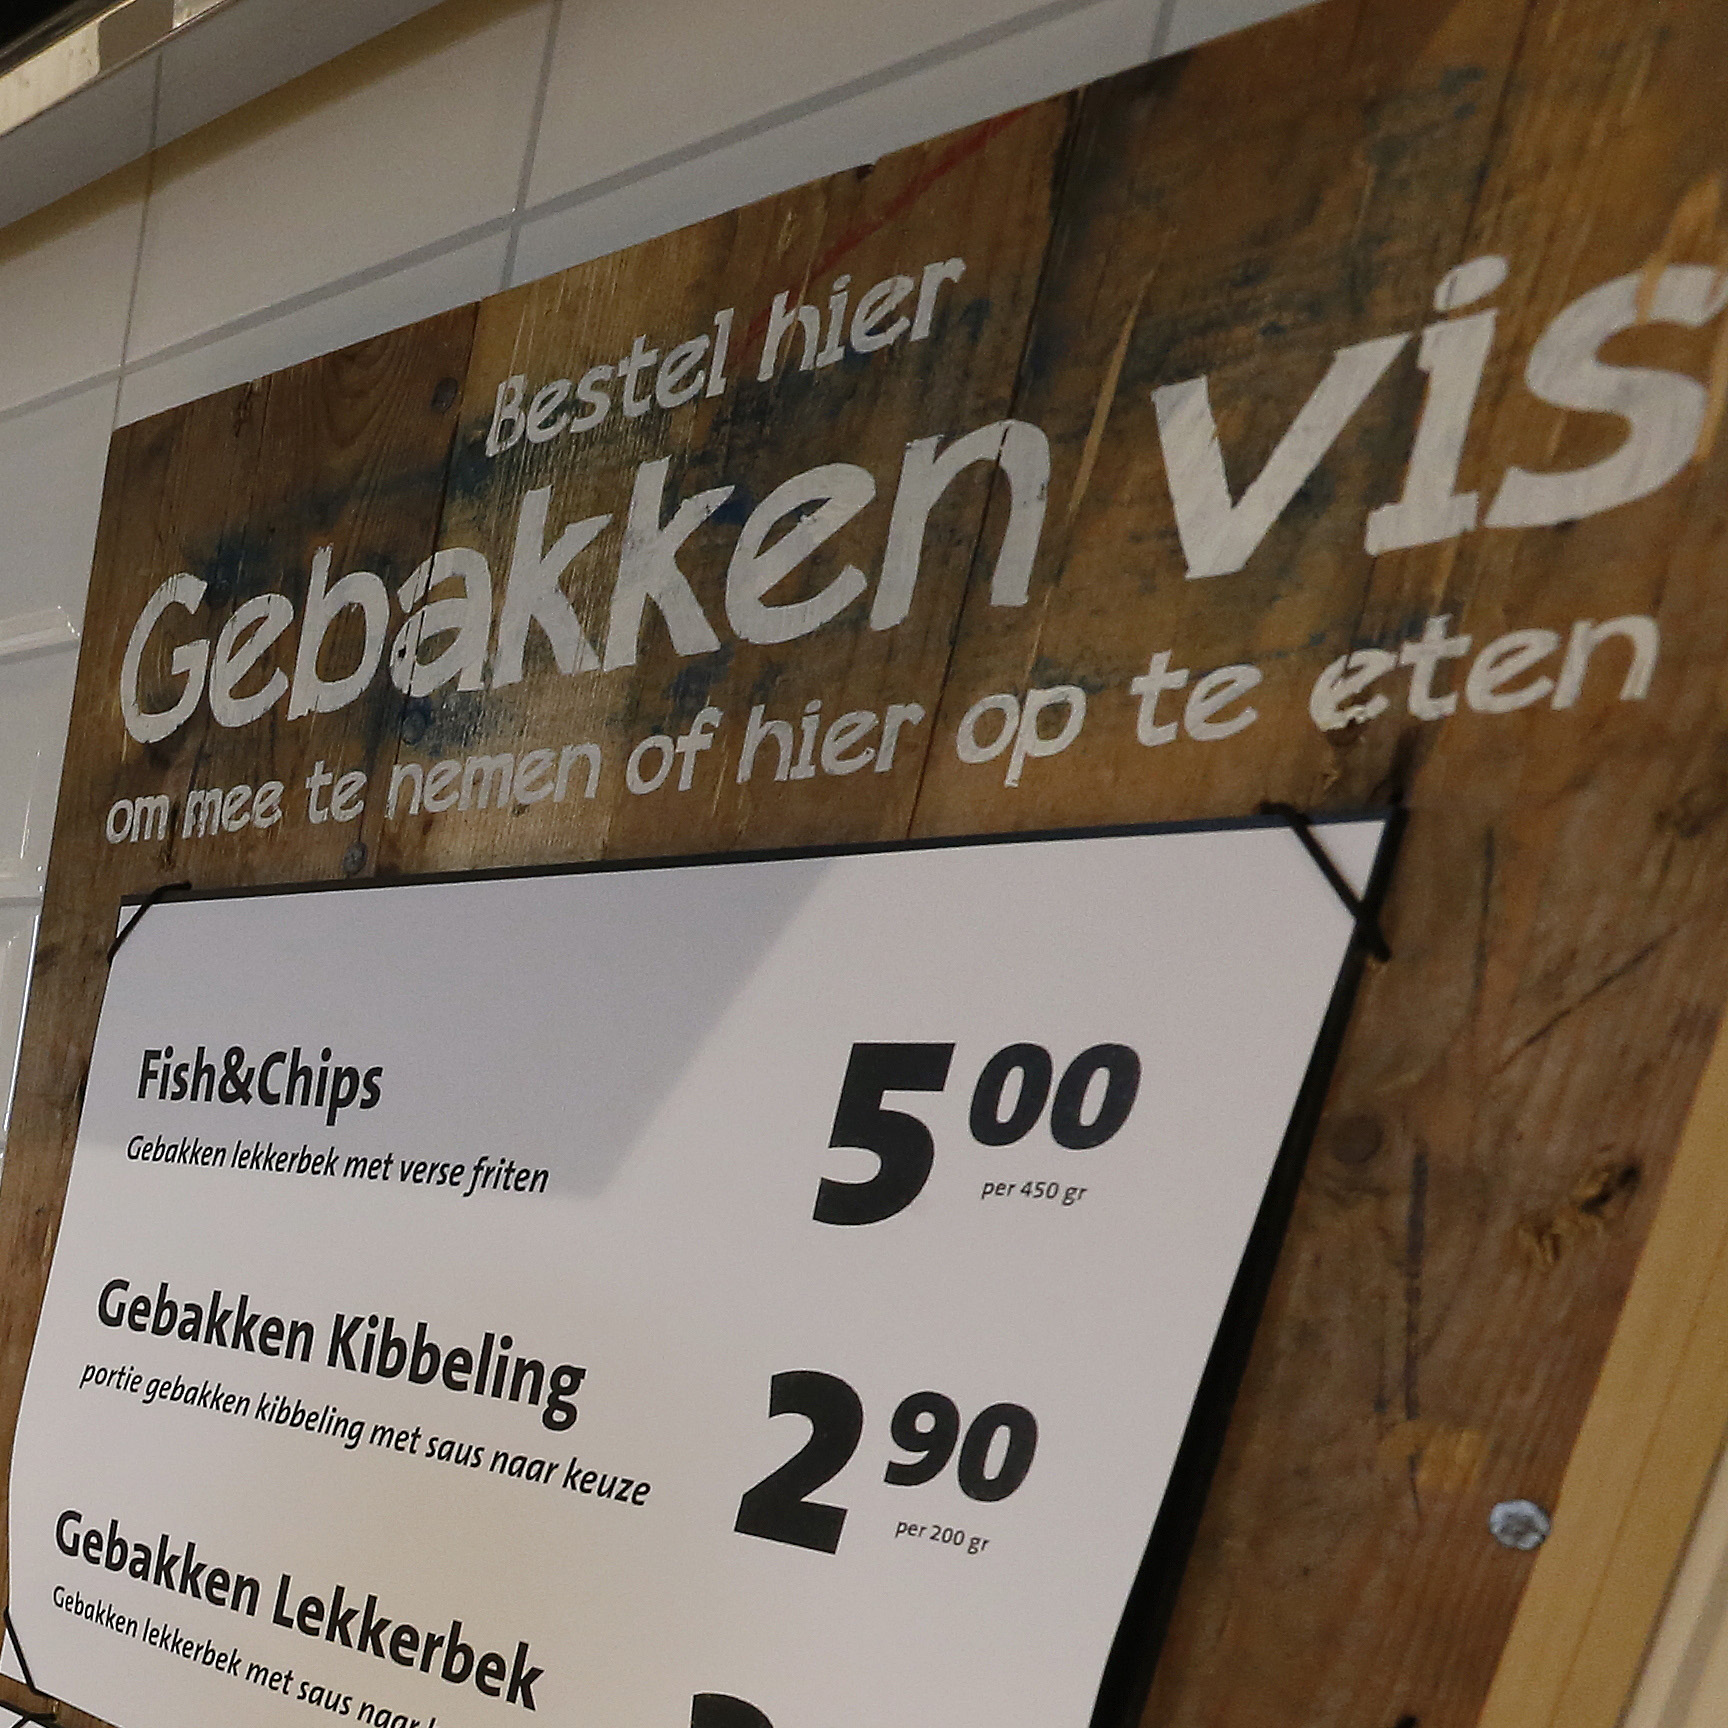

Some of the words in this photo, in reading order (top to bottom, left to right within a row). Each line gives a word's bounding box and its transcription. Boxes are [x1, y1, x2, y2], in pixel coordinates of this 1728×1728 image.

[484, 308, 734, 458] Bestel
[756, 258, 966, 384] hier
[119, 420, 1050, 745] Gebakken
[1151, 255, 1728, 579] vis
[106, 792, 168, 843] om
[181, 778, 282, 839] mee
[306, 760, 365, 825] te
[384, 738, 602, 818] nemen
[626, 707, 722, 796] of
[737, 698, 924, 784] hier
[955, 683, 1086, 788] op
[1130, 650, 1262, 747] te
[1309, 613, 1659, 732] eten
[137, 1045, 384, 1127] Fish&Chips
[127, 1134, 227, 1168] Gebakken
[231, 1139, 340, 1177] lekkerbek
[342, 1152, 394, 1181] met
[400, 1160, 465, 1187] verse
[462, 1155, 549, 1198] friten
[981, 1182, 1016, 1200] per
[1020, 1181, 1059, 1199] 450
[1062, 1186, 1088, 1206] gr
[98, 1278, 314, 1363] Gebakken
[326, 1313, 587, 1432] Kibbeling
[79, 1364, 143, 1393] portie
[143, 1374, 251, 1417] gebakken
[254, 1391, 366, 1449] kibbeling
[368, 1424, 422, 1455] met
[424, 1436, 484, 1469] saus
[488, 1450, 559, 1484] naar
[561, 1456, 651, 1506] keuze
[895, 1521, 927, 1538] per
[929, 1524, 965, 1546] 200
[967, 1537, 990, 1555] gr
[53, 1509, 260, 1617] Gebakken
[270, 1573, 545, 1712] Lekkerbek
[53, 1585, 138, 1638] Gebakken
[142, 1617, 242, 1677] lekkerbek
[245, 1662, 294, 1696] met
[296, 1681, 353, 1716] saus
